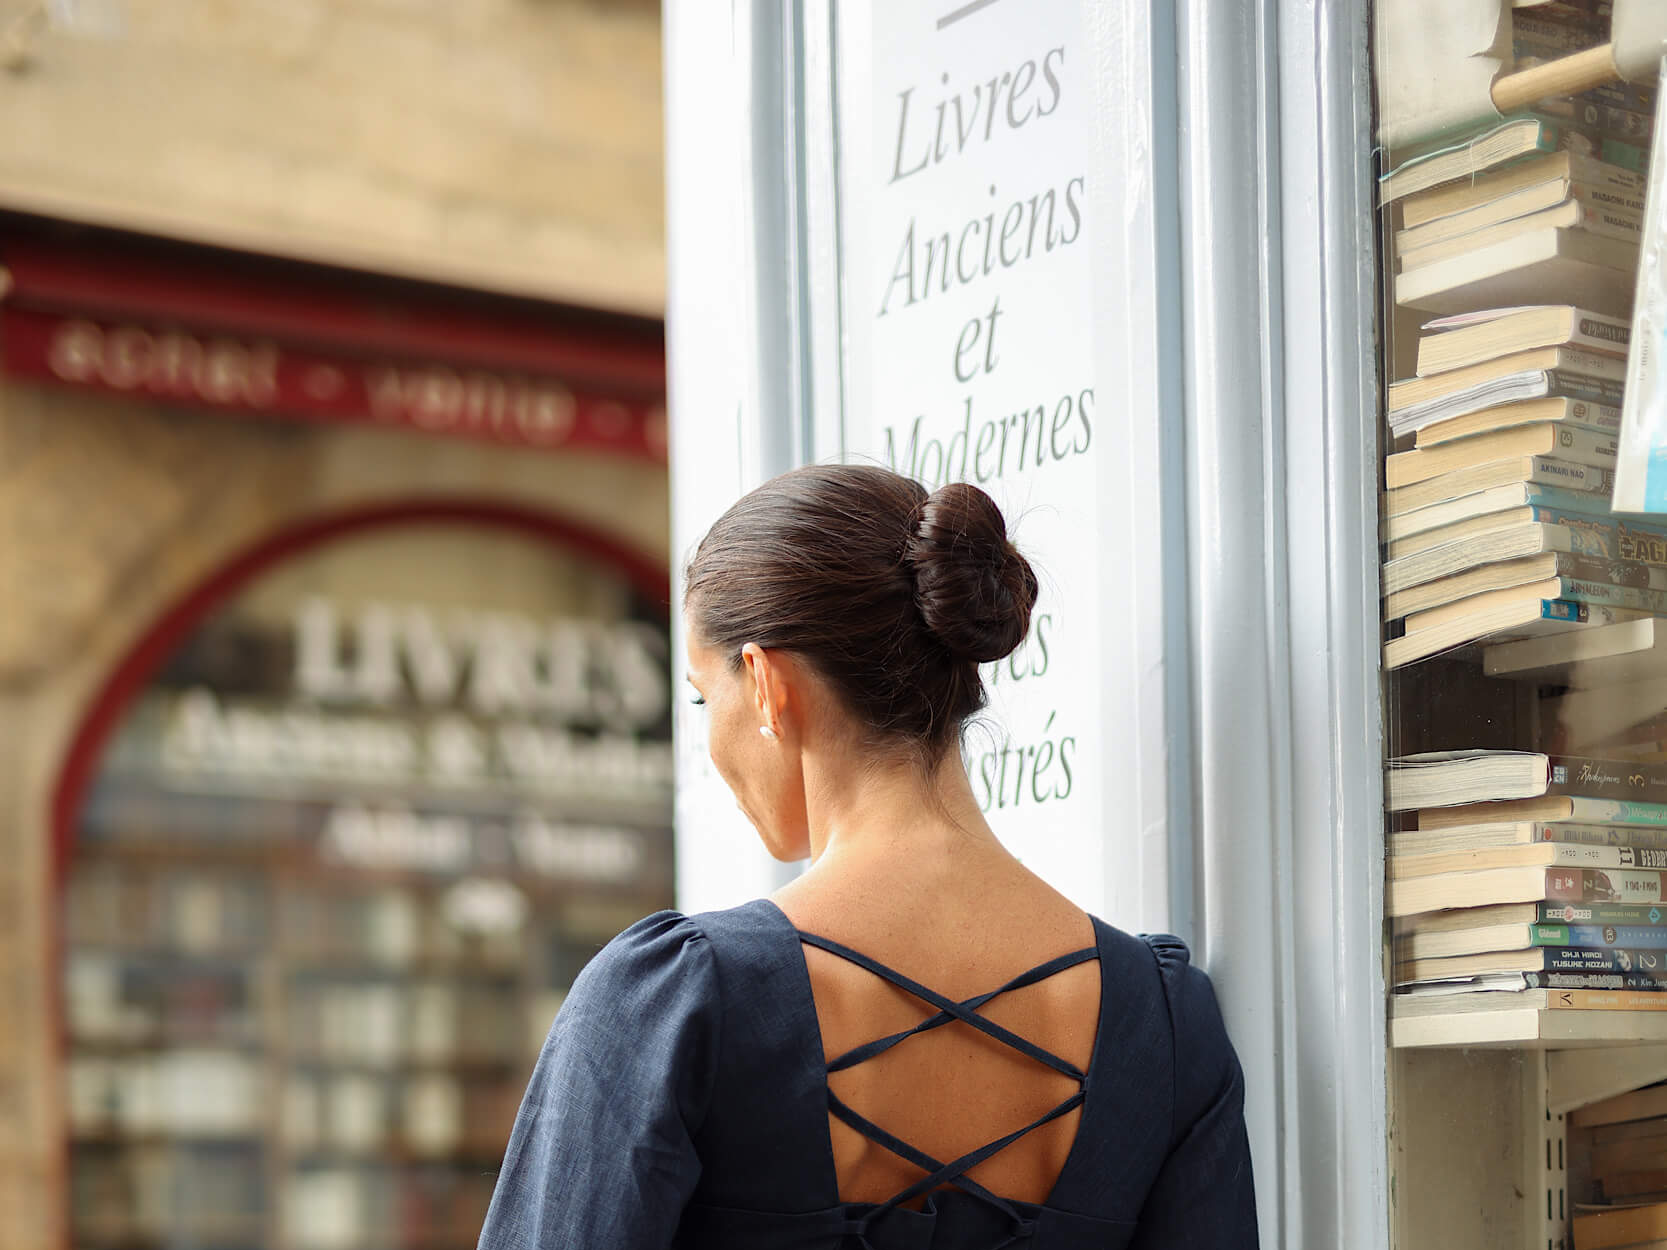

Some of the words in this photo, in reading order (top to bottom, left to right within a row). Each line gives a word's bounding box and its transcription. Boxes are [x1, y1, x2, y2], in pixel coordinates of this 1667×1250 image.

[889, 45, 1065, 185] Livres
[877, 176, 1084, 317] Anciens
[954, 296, 1004, 383] et
[295, 597, 668, 727] LIVRES
